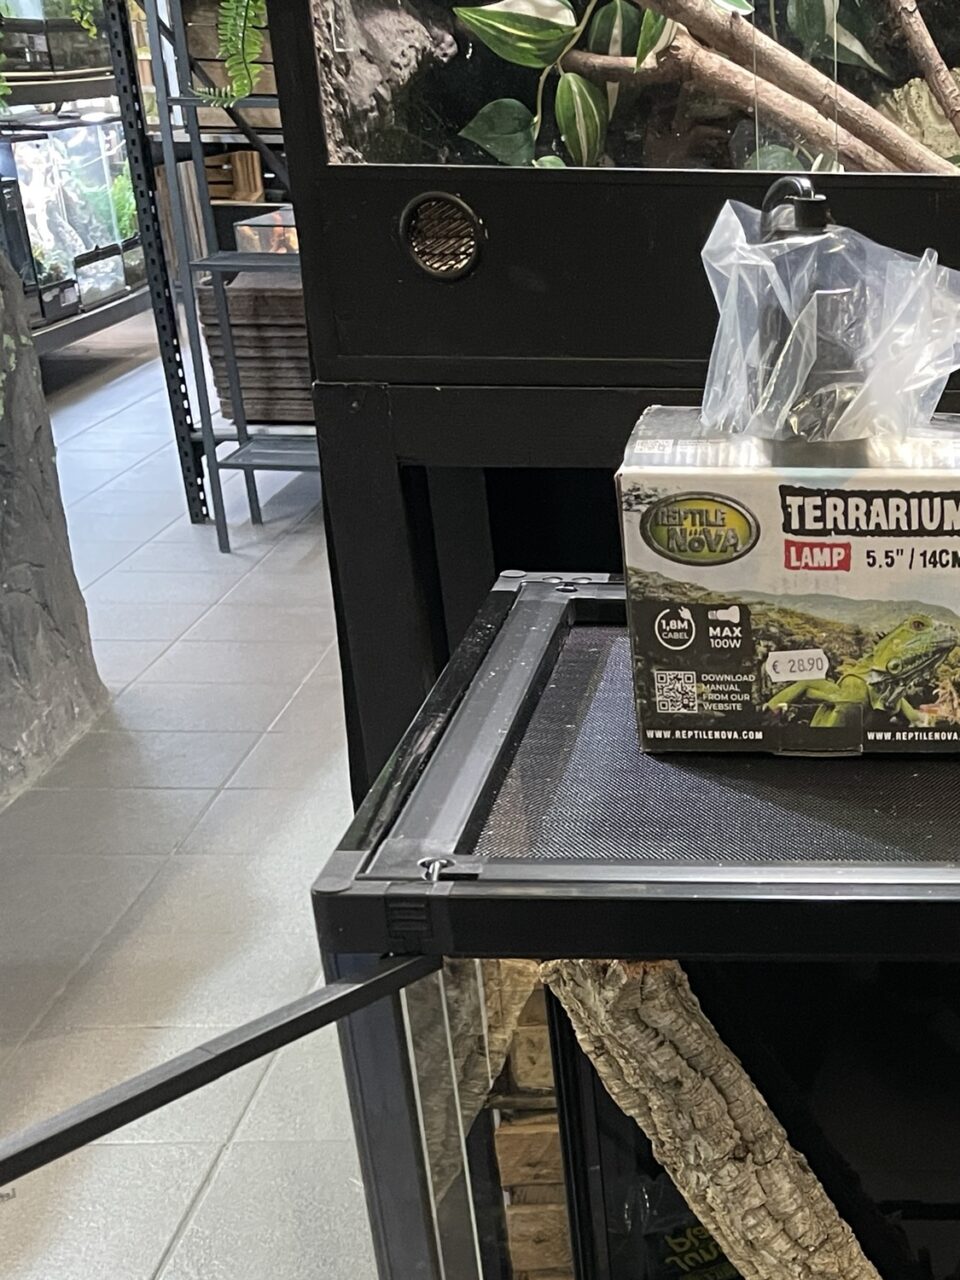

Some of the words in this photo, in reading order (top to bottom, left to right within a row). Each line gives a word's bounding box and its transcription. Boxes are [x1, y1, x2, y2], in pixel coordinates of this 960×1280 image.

[655, 506, 727, 527] REPTILE
[666, 526, 741, 553] NOVA
[789, 545, 845, 568] LAMP
[866, 548, 904, 569] 5.5"
[660, 619, 689, 632] 1,8M
[662, 631, 690, 640] CABEL
[708, 626, 743, 638] MAX
[710, 638, 742, 649] 100W
[771, 660, 780, 675] €
[787, 656, 825, 674] 28.90
[701, 673, 756, 682] DOWNLOAD
[702, 682, 741, 692] MANUAL
[702, 692, 729, 701] FROM
[730, 692, 750, 701] OUR
[702, 702, 743, 711] WEBSITE
[645, 729, 764, 740] WWW.REPTILENOVA.COM
